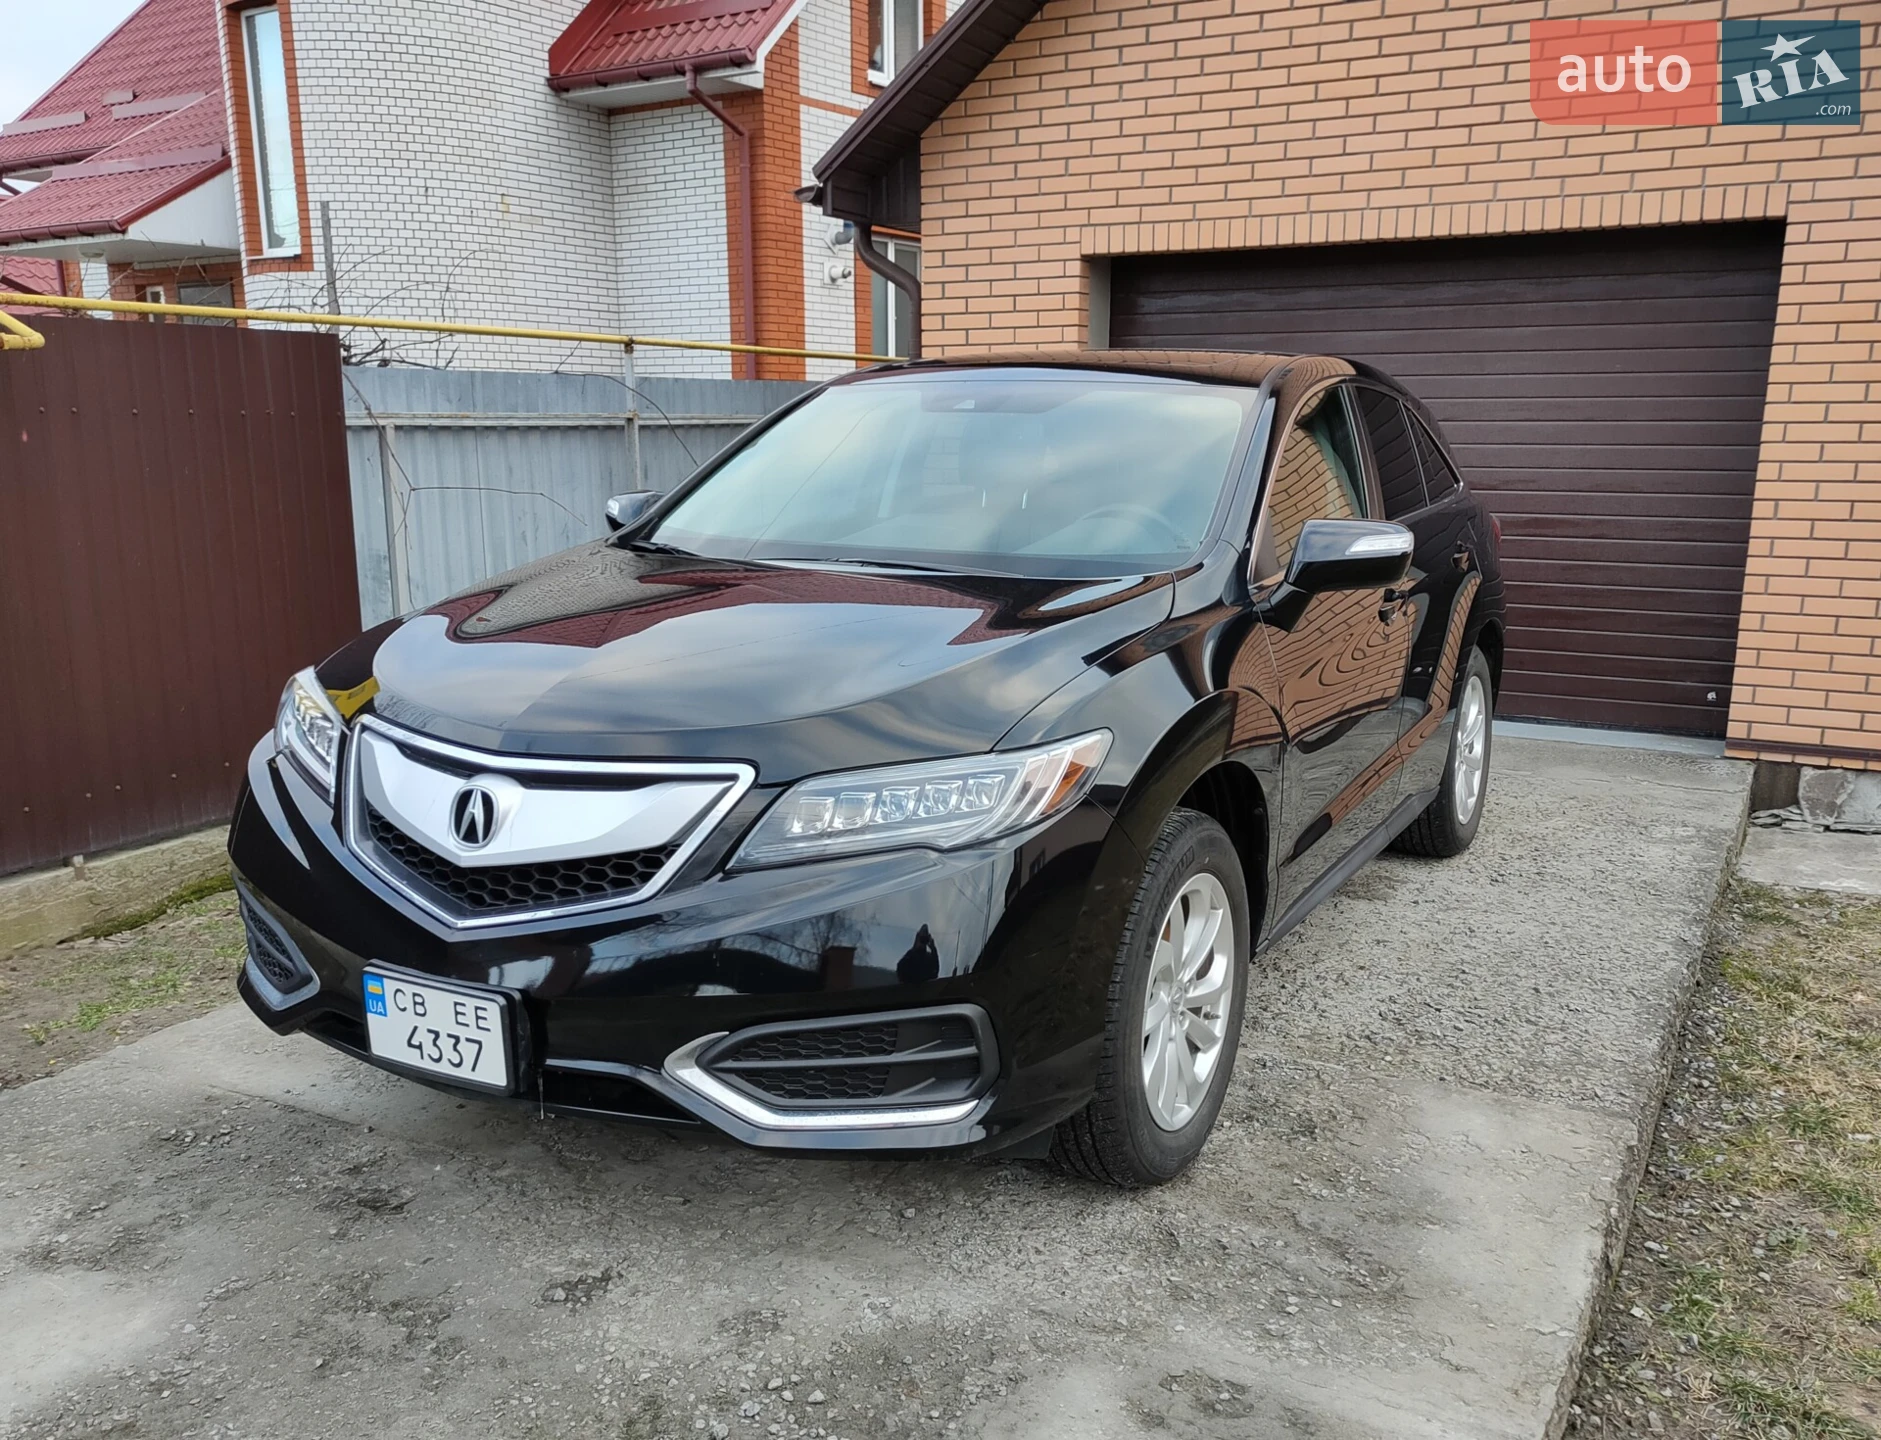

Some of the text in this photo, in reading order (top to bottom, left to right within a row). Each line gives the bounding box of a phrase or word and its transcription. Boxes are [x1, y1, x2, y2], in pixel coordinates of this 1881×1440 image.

[369, 999, 385, 1014] UA
[393, 988, 491, 1032] CB EE
[407, 1025, 483, 1072] 4337
